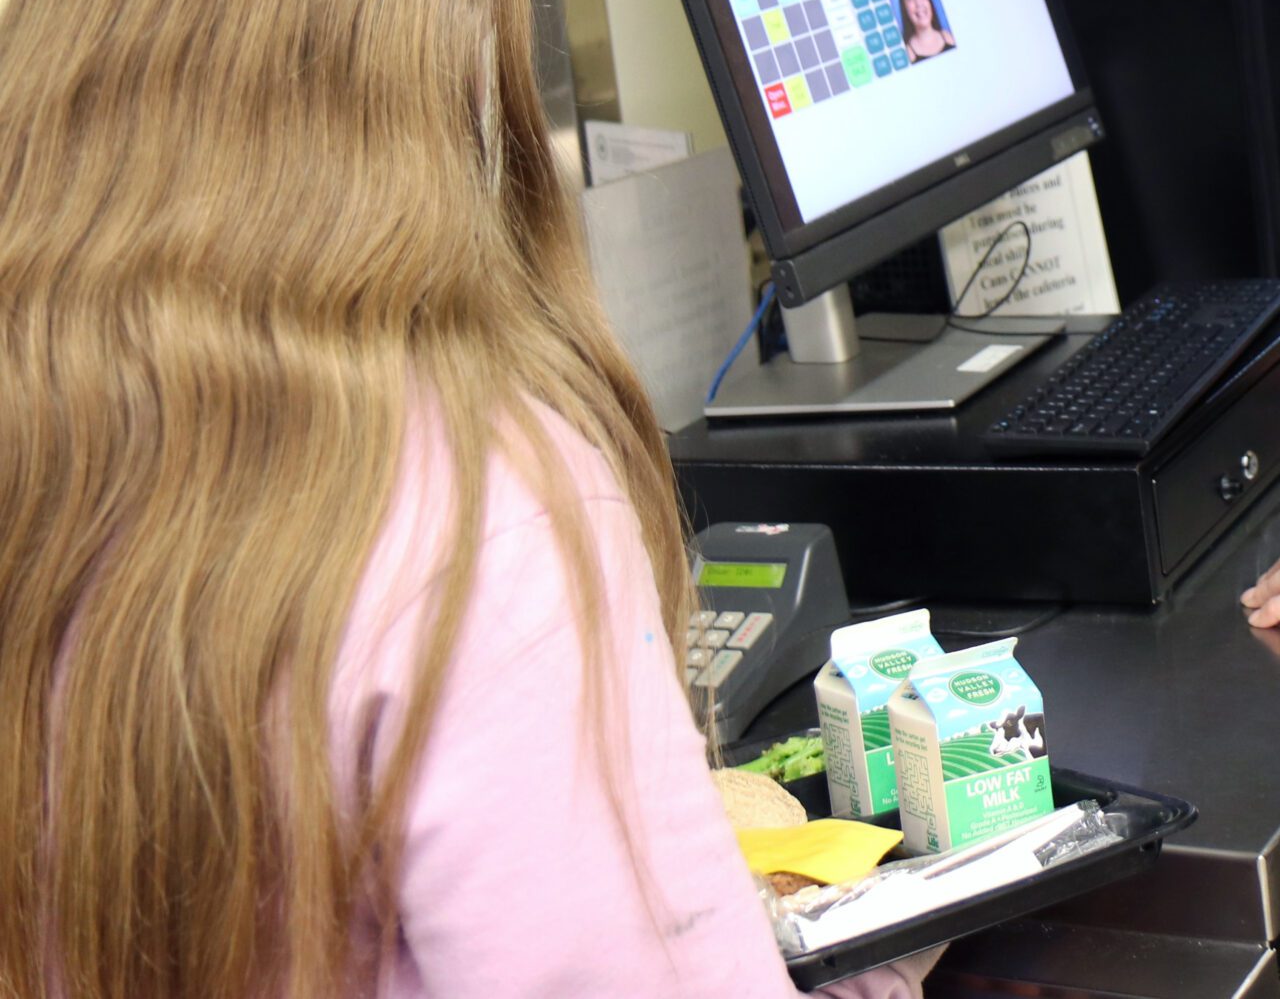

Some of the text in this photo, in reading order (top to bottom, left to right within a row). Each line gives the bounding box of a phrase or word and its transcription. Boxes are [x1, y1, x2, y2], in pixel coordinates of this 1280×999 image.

[878, 656, 913, 670] VALLEY
[953, 674, 990, 688] HUDSON
[957, 679, 994, 694] VALLEY
[967, 687, 996, 700] FRESH
[966, 766, 1033, 797] LOW FAT
[982, 786, 1021, 808] MILK
